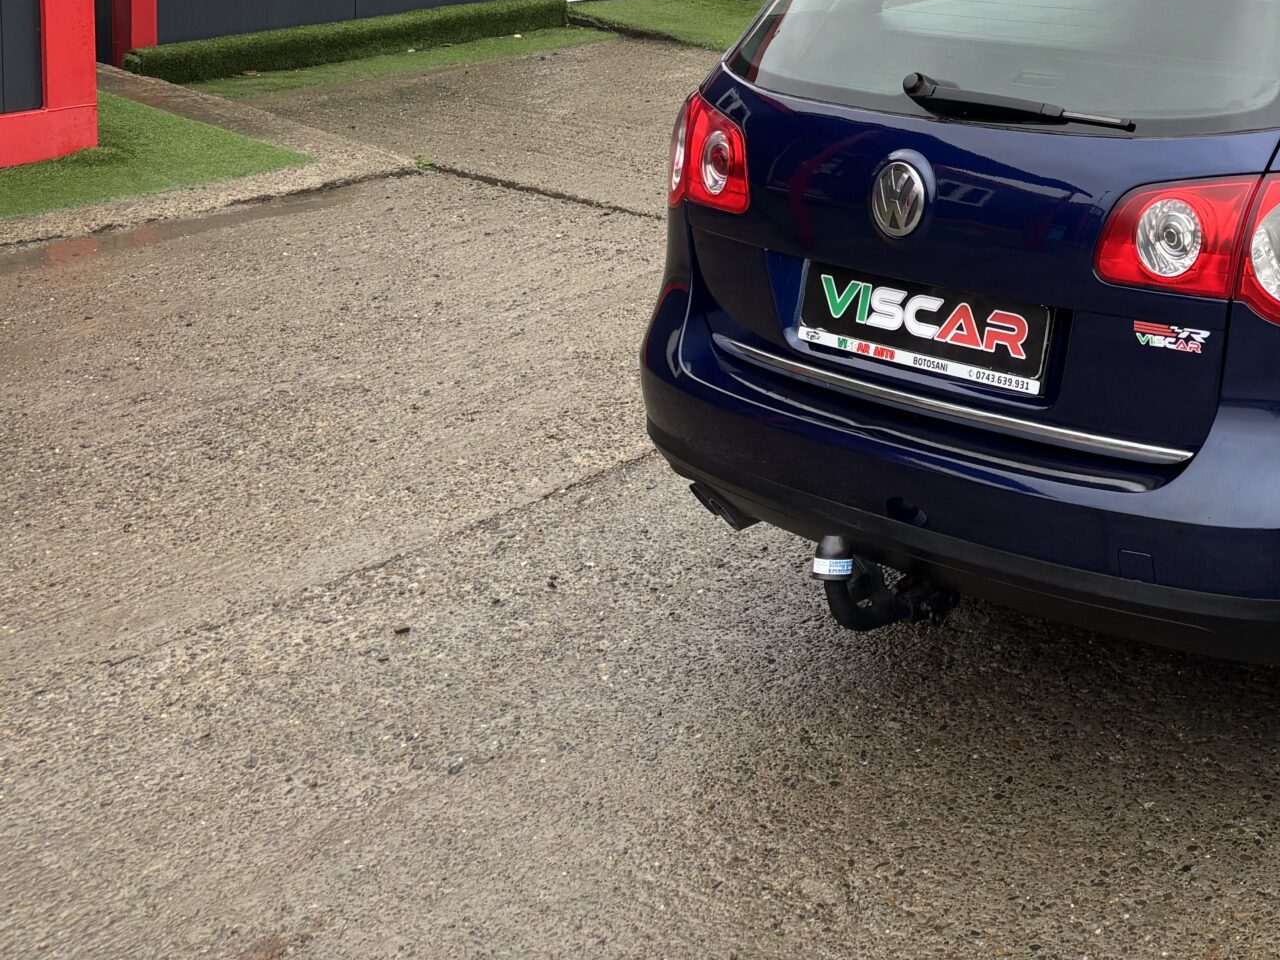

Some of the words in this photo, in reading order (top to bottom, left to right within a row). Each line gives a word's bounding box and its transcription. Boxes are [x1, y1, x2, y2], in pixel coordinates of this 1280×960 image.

[821, 274, 1029, 360] VISCAR
[1136, 332, 1202, 354] VISCAR
[912, 356, 949, 372] BOTOSANI
[975, 370, 1030, 391] 0743.639.931
